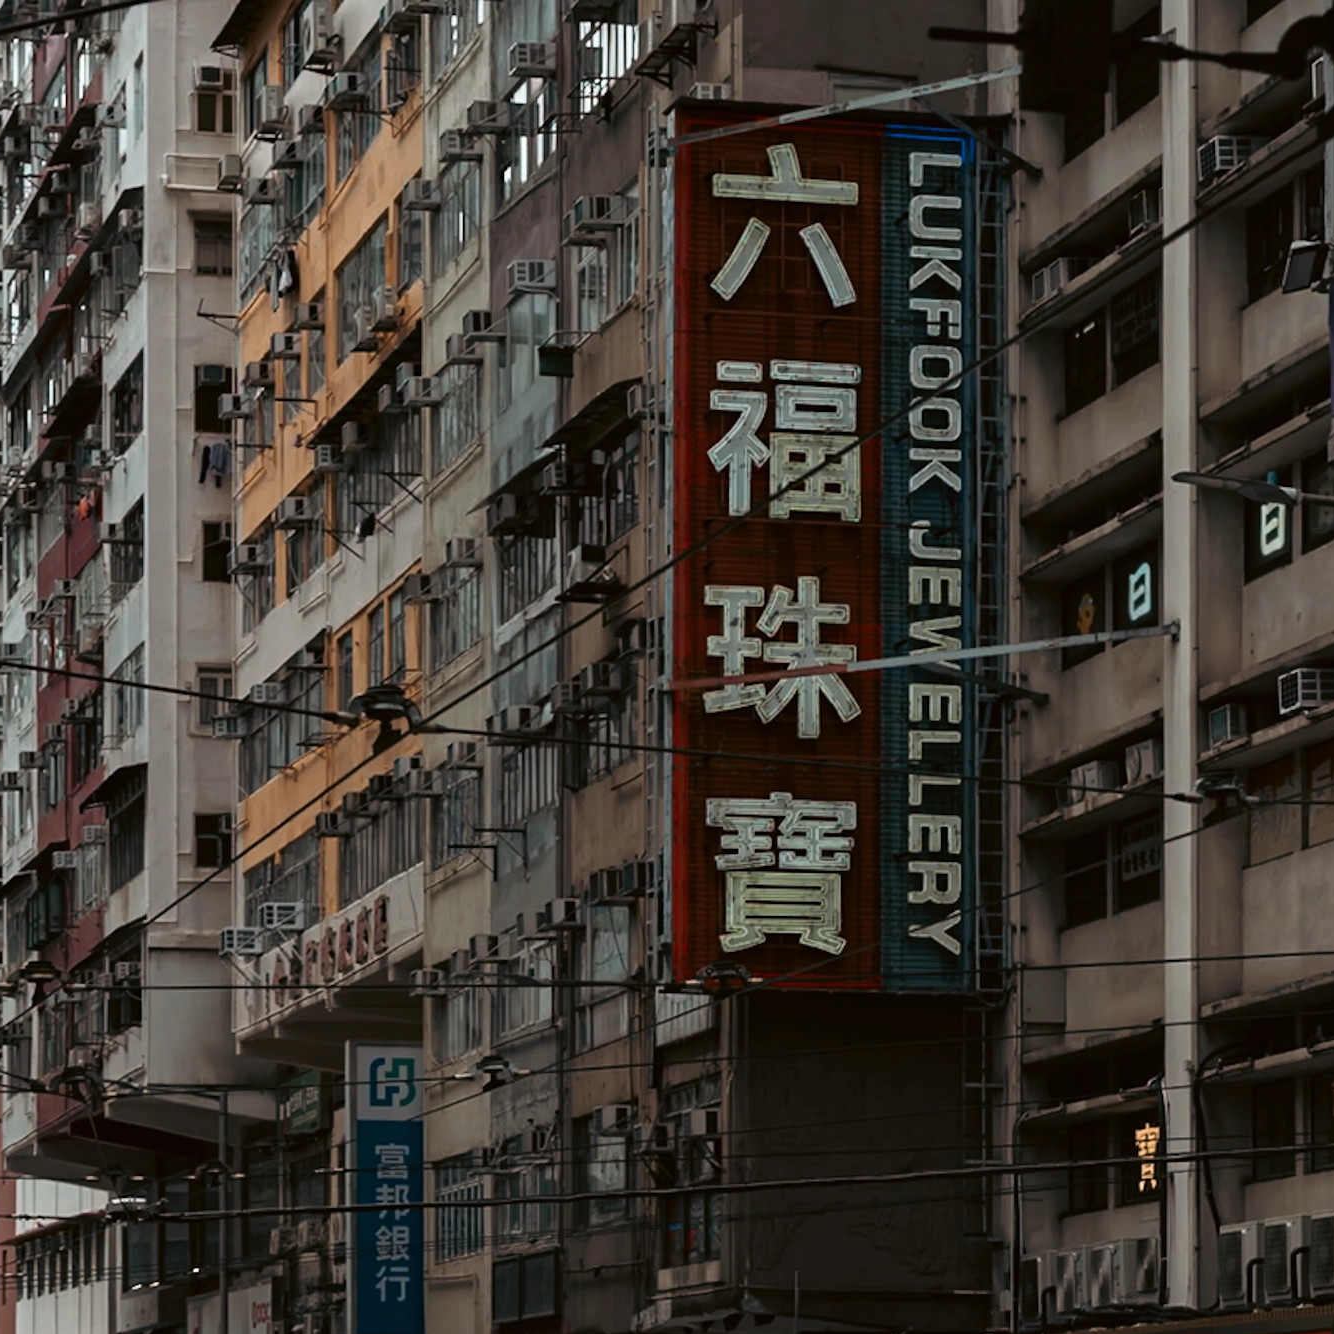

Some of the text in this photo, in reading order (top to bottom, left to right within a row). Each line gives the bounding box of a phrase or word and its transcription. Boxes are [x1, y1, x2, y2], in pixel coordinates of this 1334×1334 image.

[703, 142, 862, 956] 六福珠寶
[908, 151, 963, 956] LUKFOOK JEWELLERY
[375, 1143, 410, 1303] 富邦銀行
